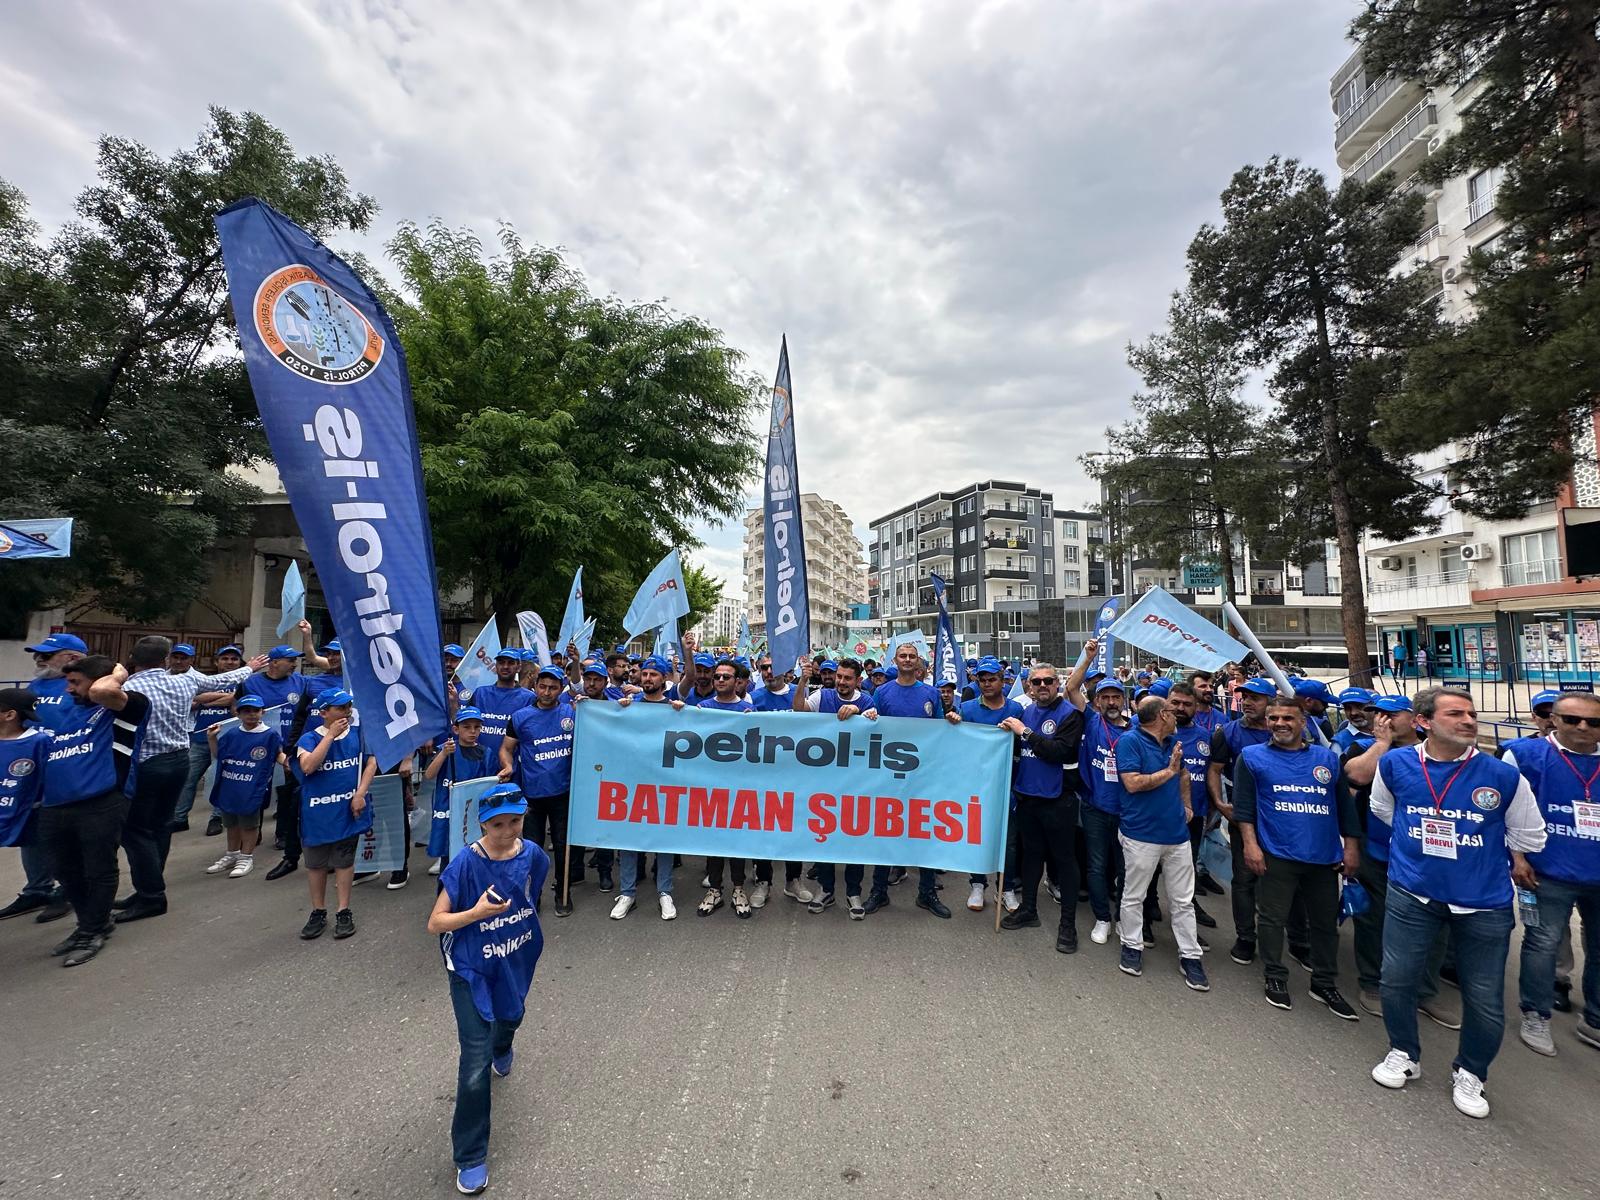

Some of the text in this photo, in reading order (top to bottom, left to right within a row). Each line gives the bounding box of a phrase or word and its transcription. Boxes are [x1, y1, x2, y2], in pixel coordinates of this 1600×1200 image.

[534, 747, 572, 762] SENDİKAS
[662, 726, 921, 780] petrol-iş
[309, 788, 356, 807] petrol
[1272, 784, 1328, 796] petrol-iş
[597, 780, 982, 846] BATMAN ŞUBESİ
[1274, 801, 1330, 815] SENDİKASI
[1406, 805, 1485, 824] petrol-iş
